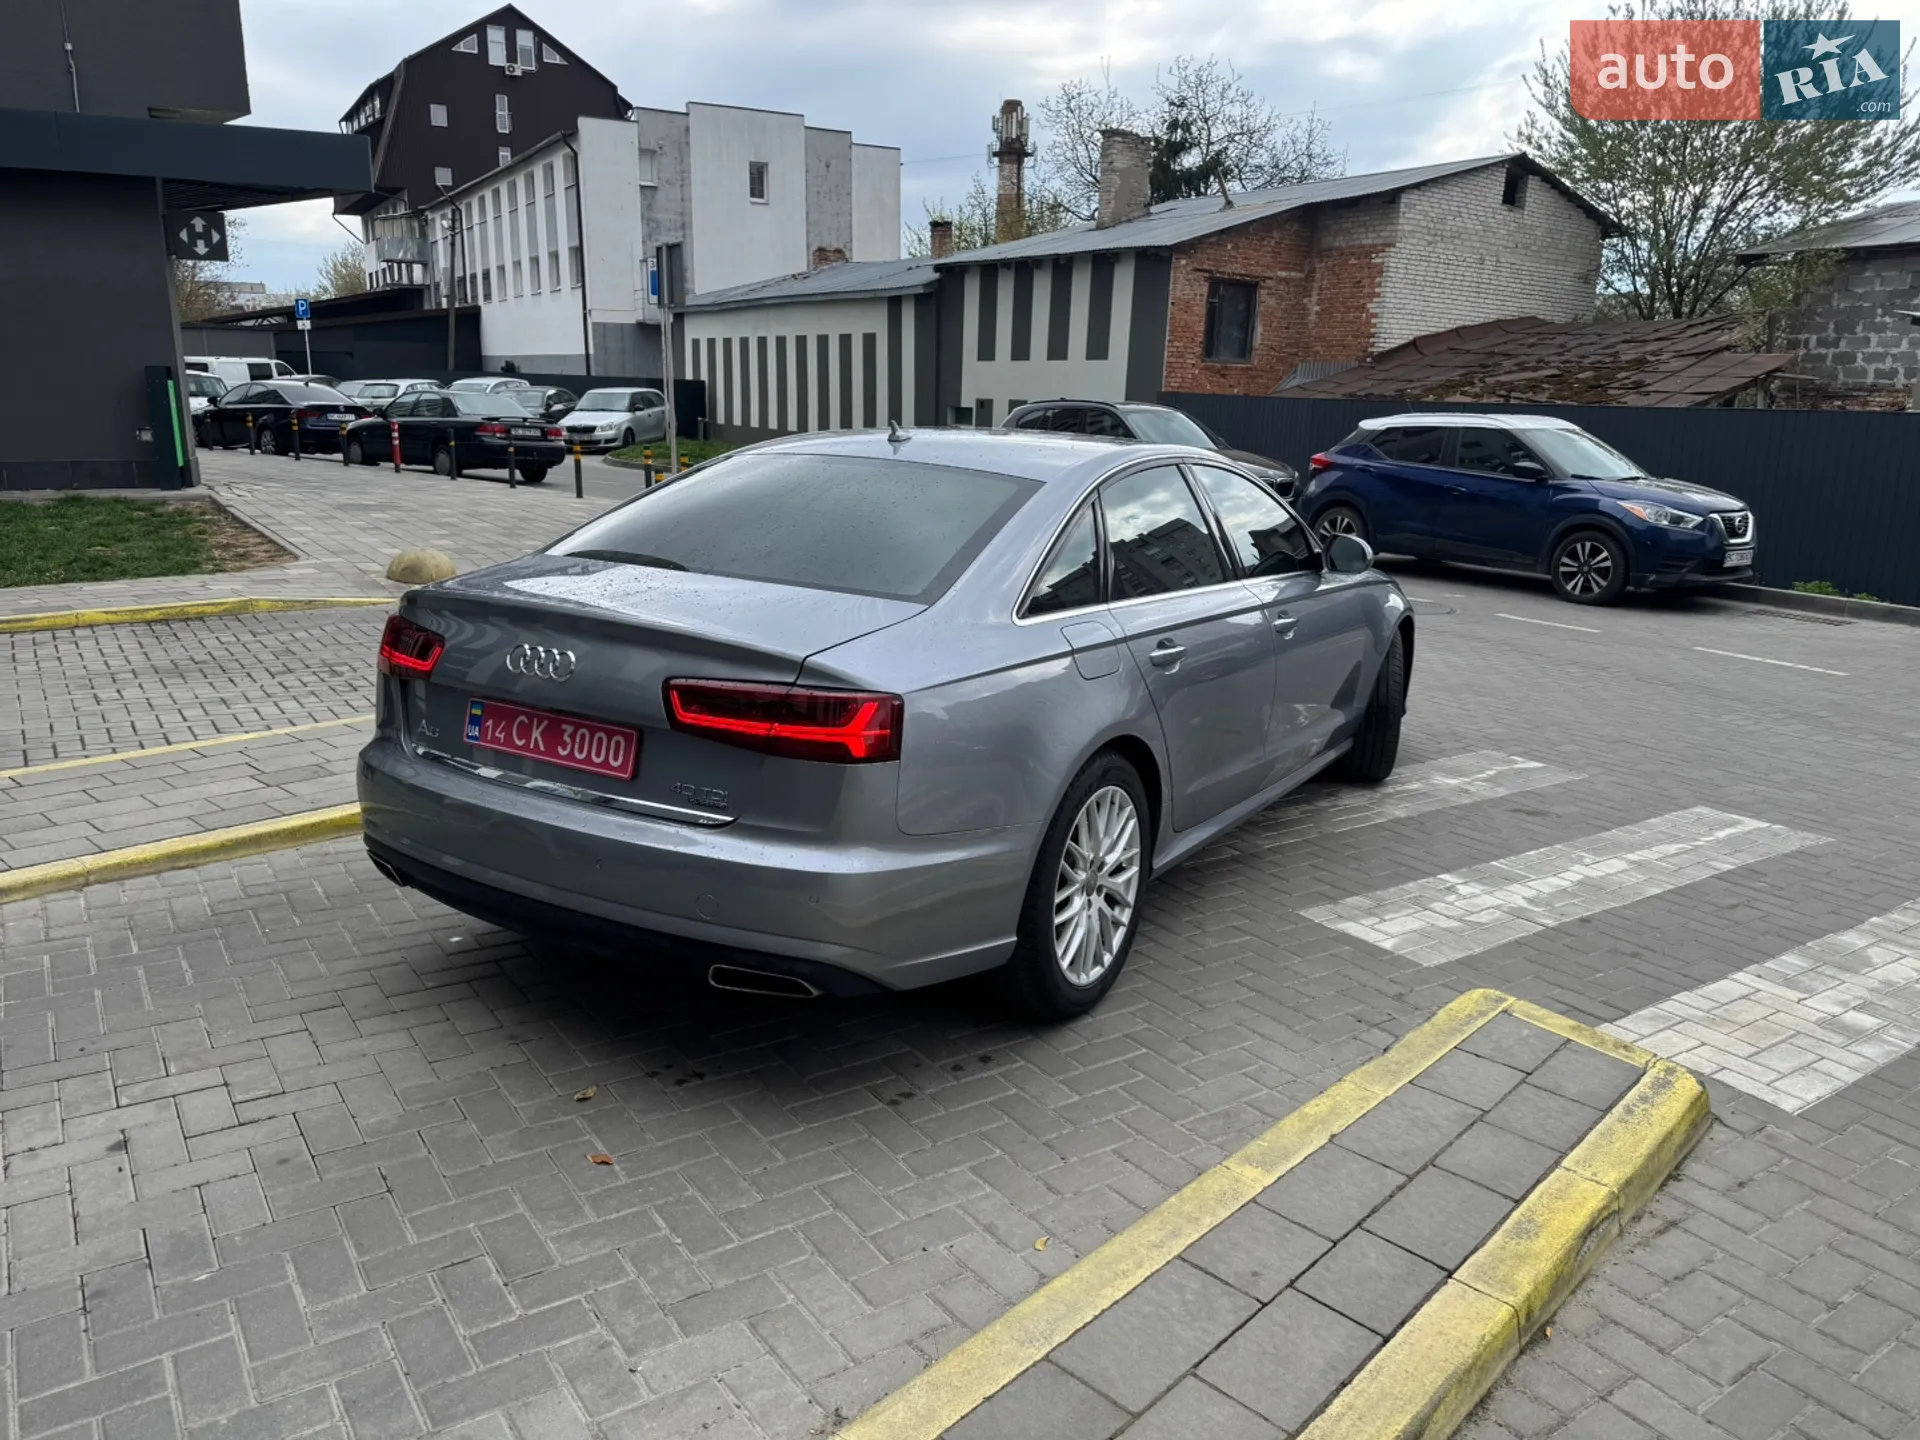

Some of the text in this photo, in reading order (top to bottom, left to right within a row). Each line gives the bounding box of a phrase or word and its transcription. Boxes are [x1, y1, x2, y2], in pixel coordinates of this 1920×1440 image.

[298, 300, 307, 315] P
[467, 724, 480, 737] UA
[485, 715, 626, 768] 14 CK 3000
